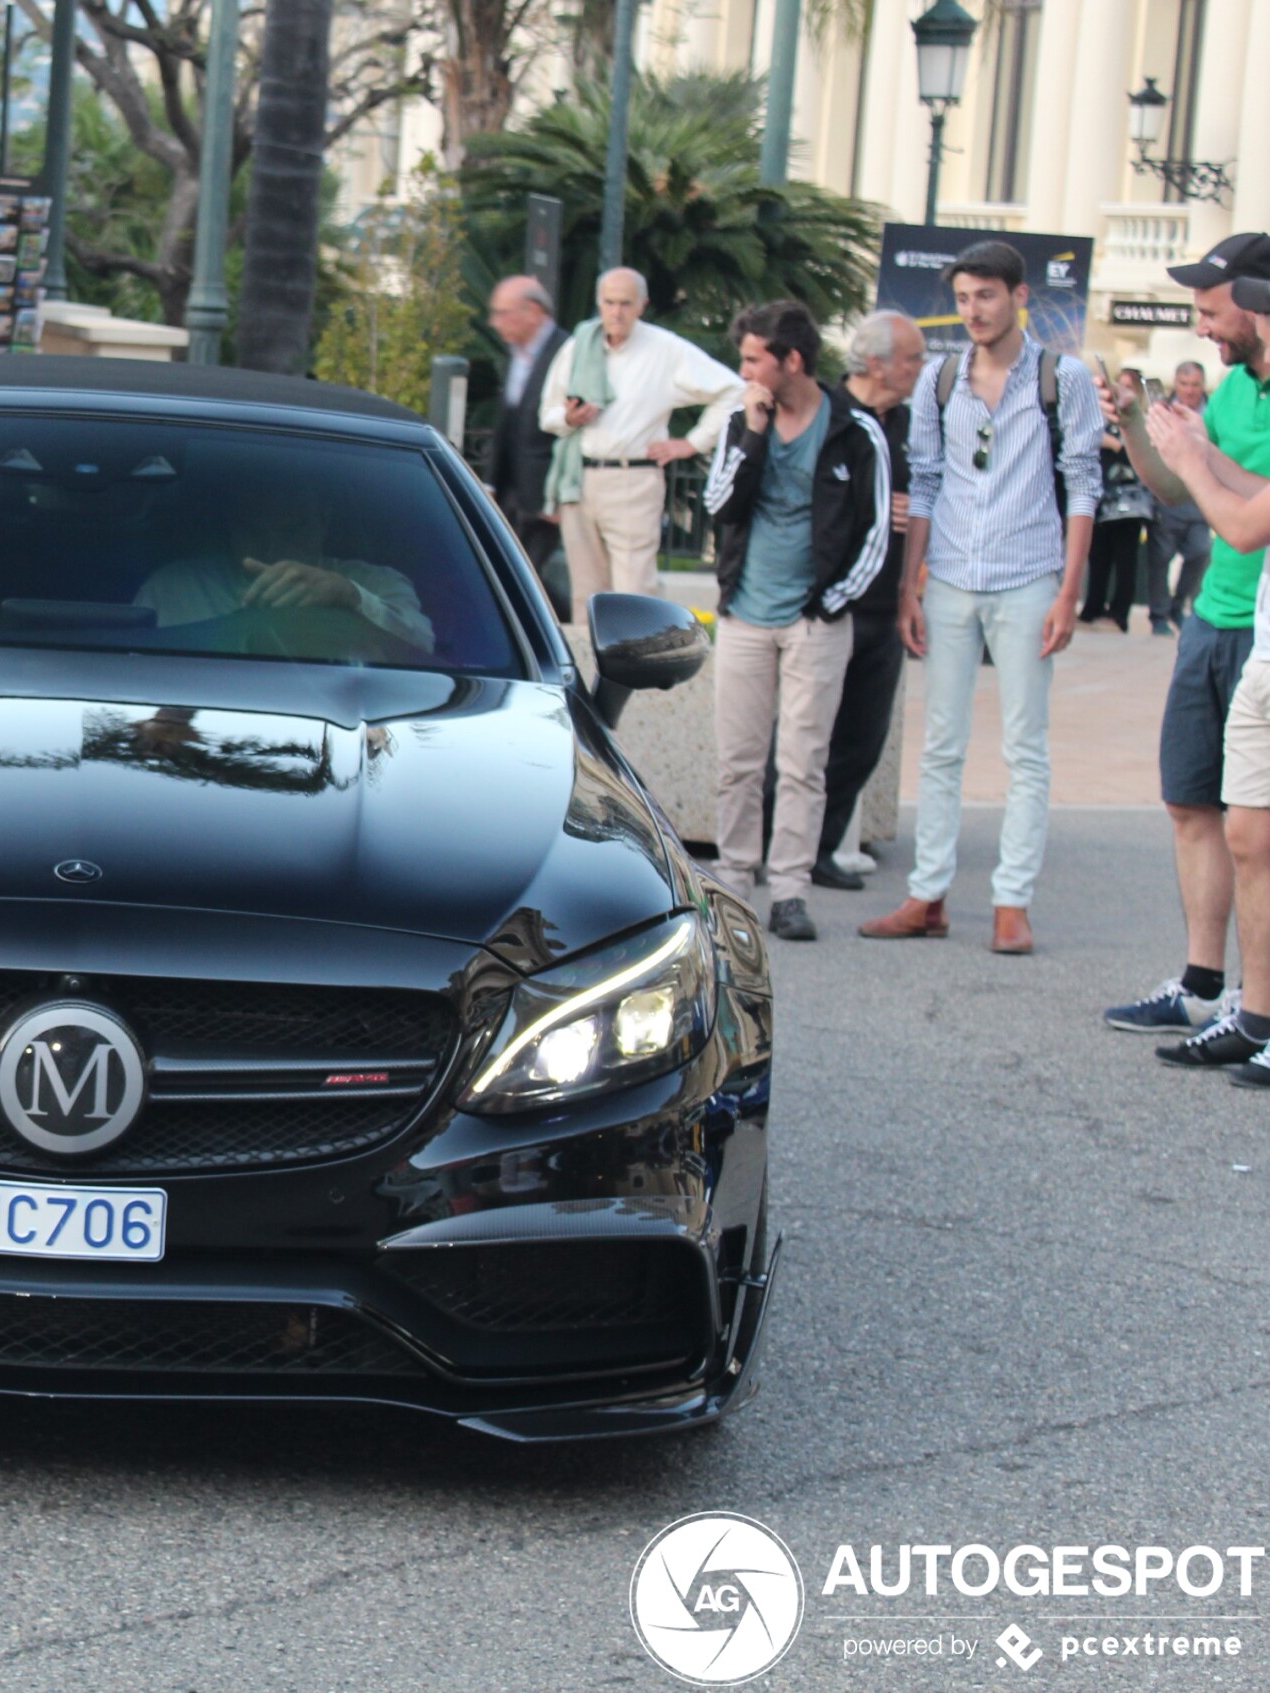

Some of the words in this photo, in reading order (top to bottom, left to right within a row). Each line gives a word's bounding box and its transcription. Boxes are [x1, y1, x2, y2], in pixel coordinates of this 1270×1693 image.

[1046, 260, 1070, 278] EY
[1113, 305, 1189, 322] CHAUMET
[25, 1041, 117, 1118] M
[7, 1194, 153, 1249] C706
